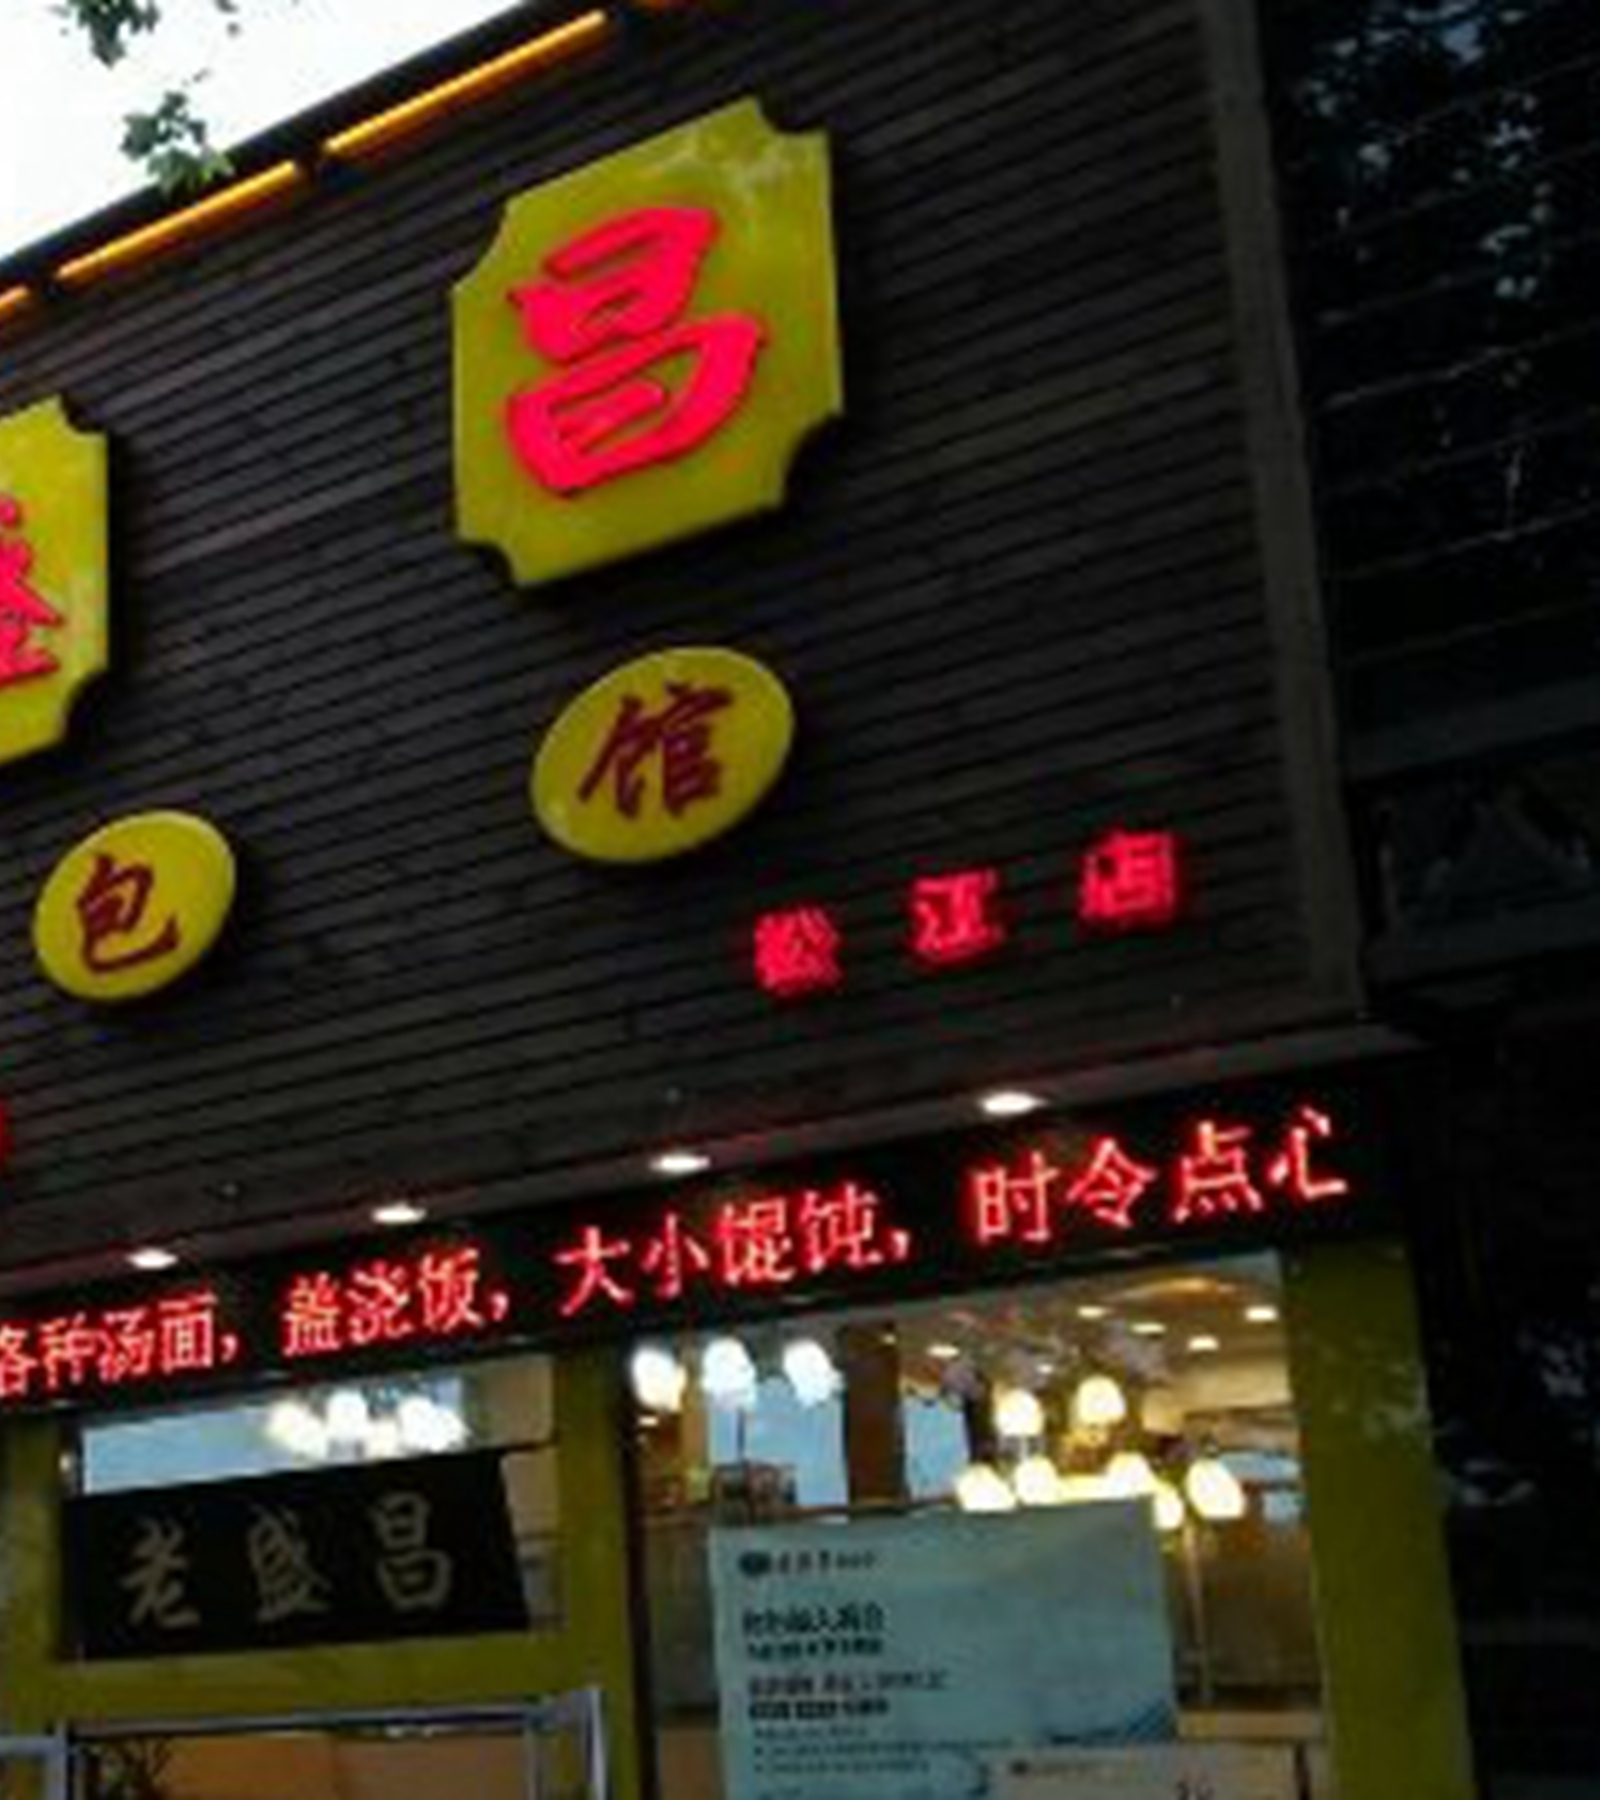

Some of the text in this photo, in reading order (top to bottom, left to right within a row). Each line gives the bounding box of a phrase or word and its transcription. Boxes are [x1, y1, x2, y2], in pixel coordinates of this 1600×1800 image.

[754, 828, 1178, 994] 松江店
[120, 1490, 452, 1628] 老盛昌
